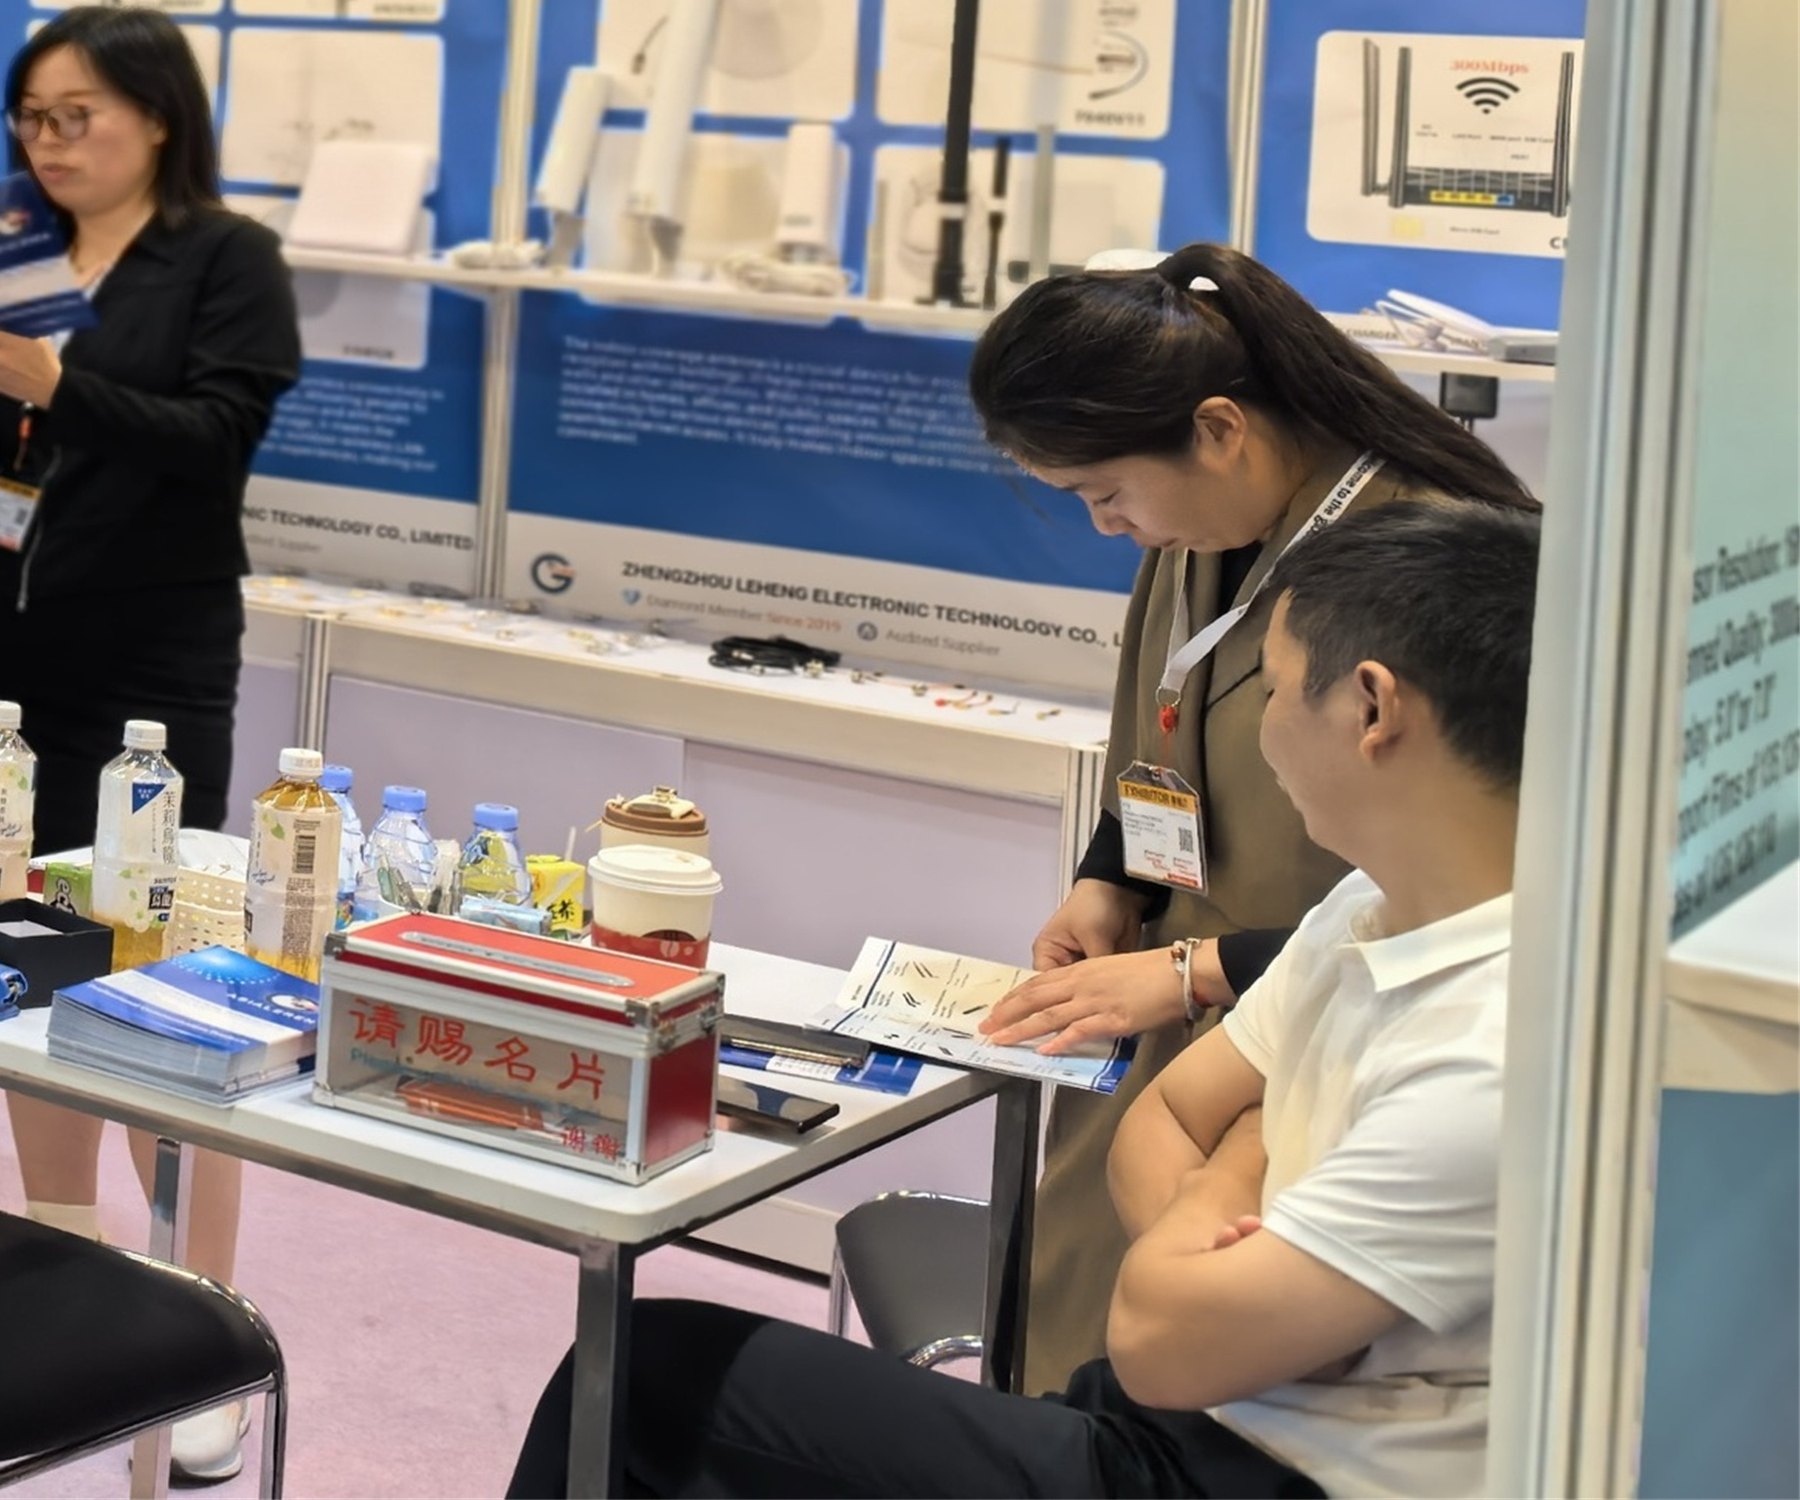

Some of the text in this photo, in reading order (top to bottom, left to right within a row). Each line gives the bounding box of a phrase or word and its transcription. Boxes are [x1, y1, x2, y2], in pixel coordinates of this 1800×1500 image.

[1451, 59, 1529, 76] 300Mbps
[1337, 487, 1352, 499] to
[1324, 499, 1342, 517] the
[622, 562, 1106, 647] ZHENGZHOU LEHENG ELECTRONIC TECHNOLOGY CO.,
[348, 998, 605, 1100] 请赐名片
[560, 1126, 622, 1161] 谢谢
